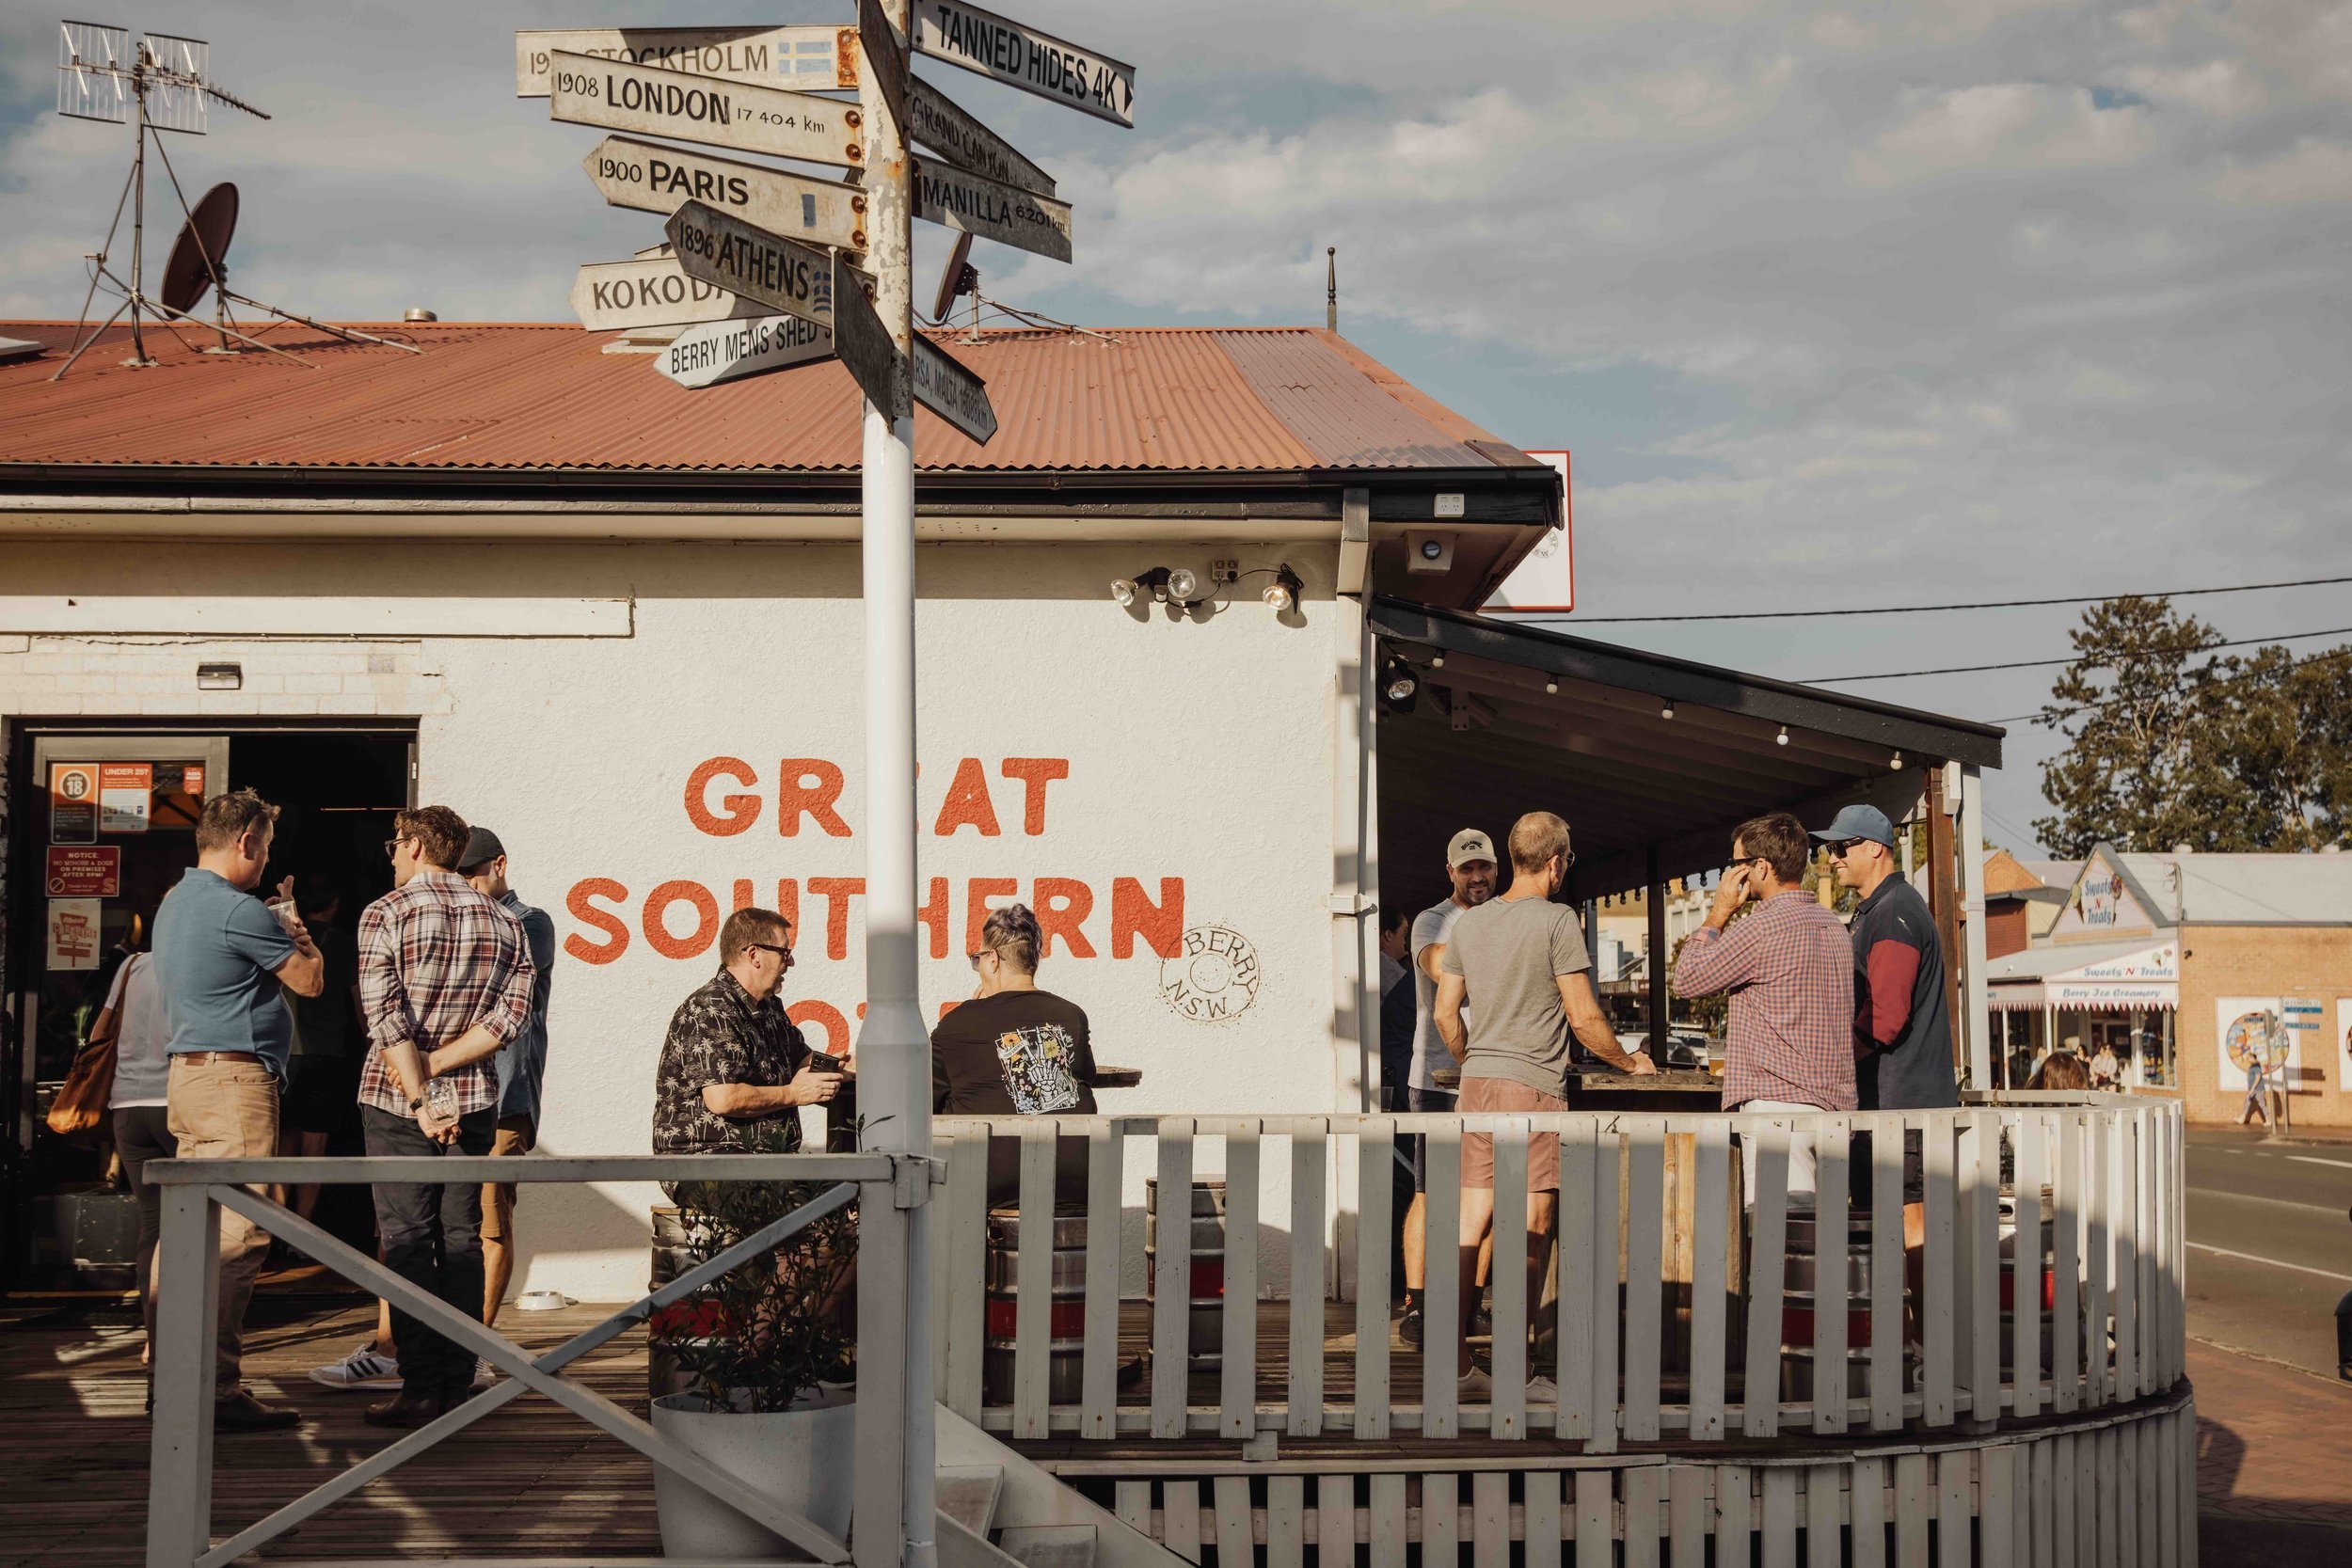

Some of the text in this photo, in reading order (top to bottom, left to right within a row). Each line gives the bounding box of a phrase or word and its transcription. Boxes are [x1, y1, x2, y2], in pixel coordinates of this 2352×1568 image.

[584, 44, 769, 72] OCKHOLM
[938, 5, 1118, 112] TANNED HIDES 4K
[557, 71, 826, 134] 1908 LONDON 17 404 km
[599, 157, 750, 206] 1900 PARIS
[923, 175, 1012, 229] MANILLA
[1016, 205, 1050, 228] 6.201
[679, 222, 809, 301] 1896 ATHENS
[672, 318, 818, 375] BERRY MENS SHED
[67, 780, 83, 796] 18
[684, 755, 1070, 838] GRAT
[2085, 879, 2112, 896] Sweets
[2088, 908, 2111, 925] Treats
[1184, 929, 1257, 996] BERRY
[2084, 967, 2122, 977] Sweets
[2140, 967, 2173, 976] Treats
[2062, 989, 2161, 999] Berry Ice Creamery
